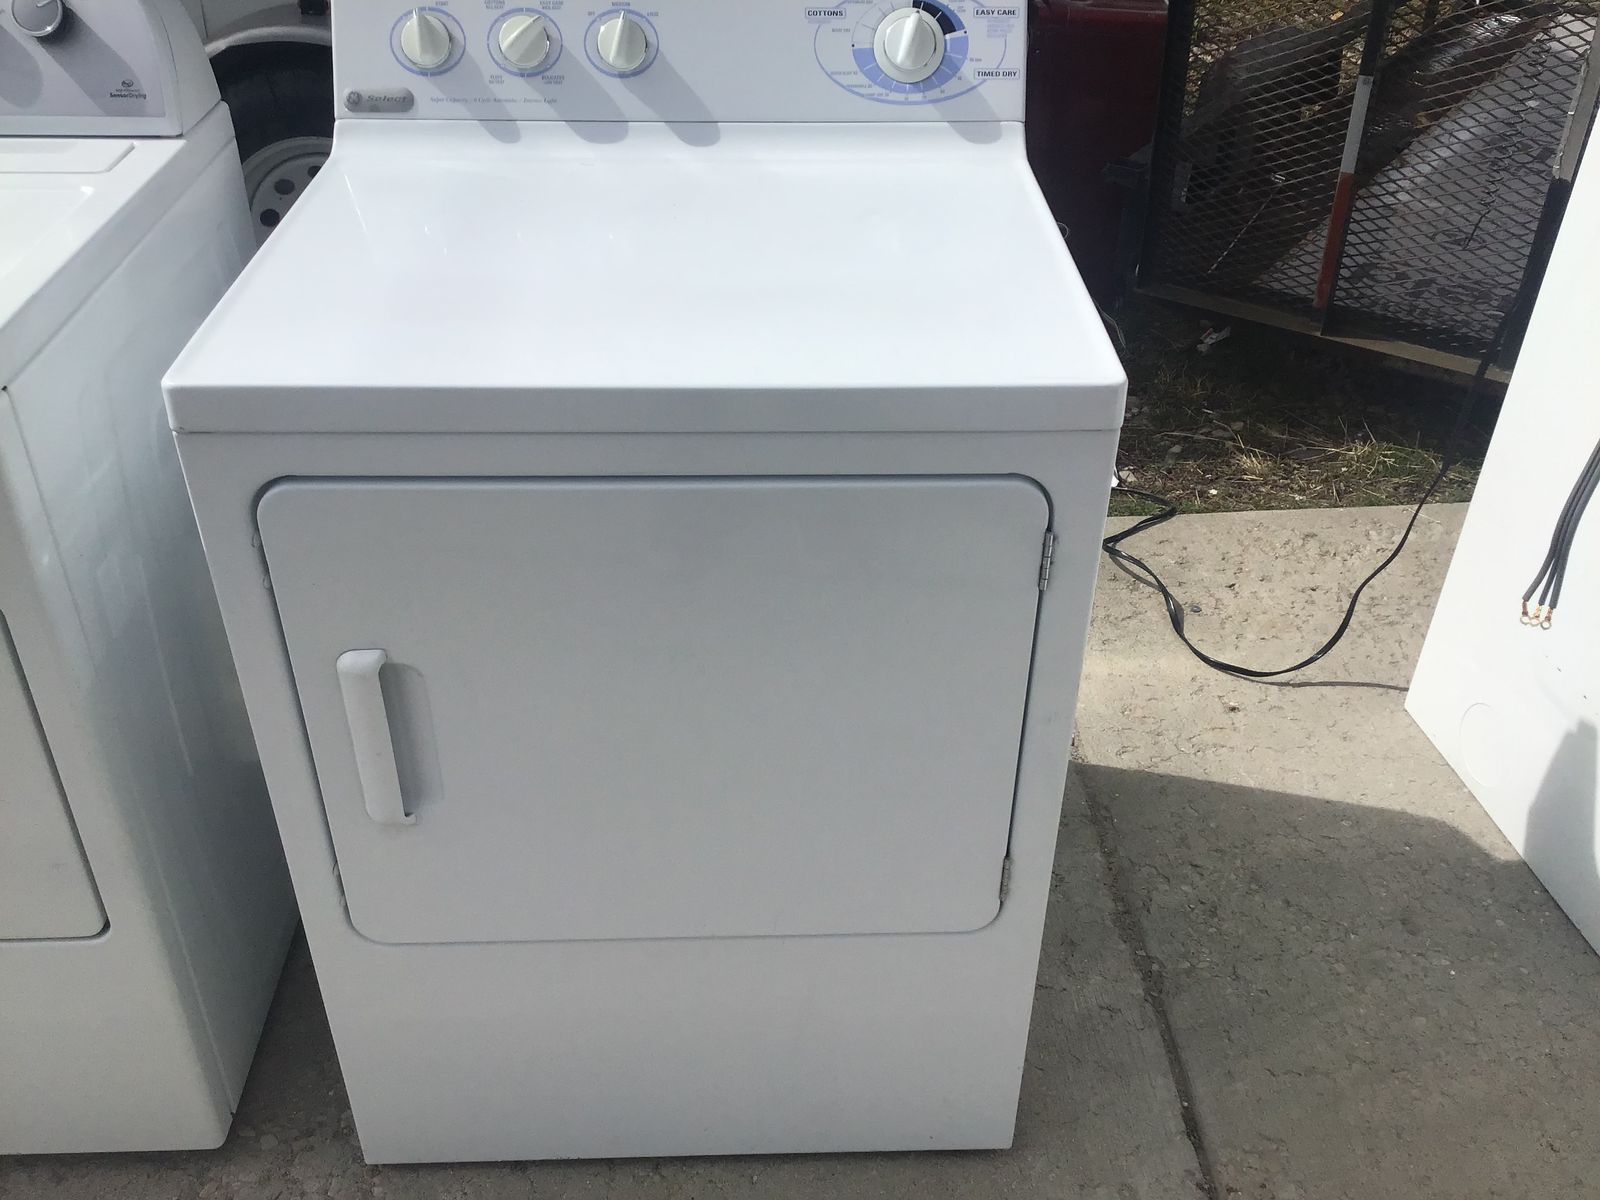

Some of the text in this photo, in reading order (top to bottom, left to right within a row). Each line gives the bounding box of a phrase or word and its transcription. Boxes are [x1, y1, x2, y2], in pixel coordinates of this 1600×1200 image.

[807, 9, 844, 17] COTTONS
[977, 70, 1018, 78] TIMED DRY
[366, 95, 408, 103] Select
